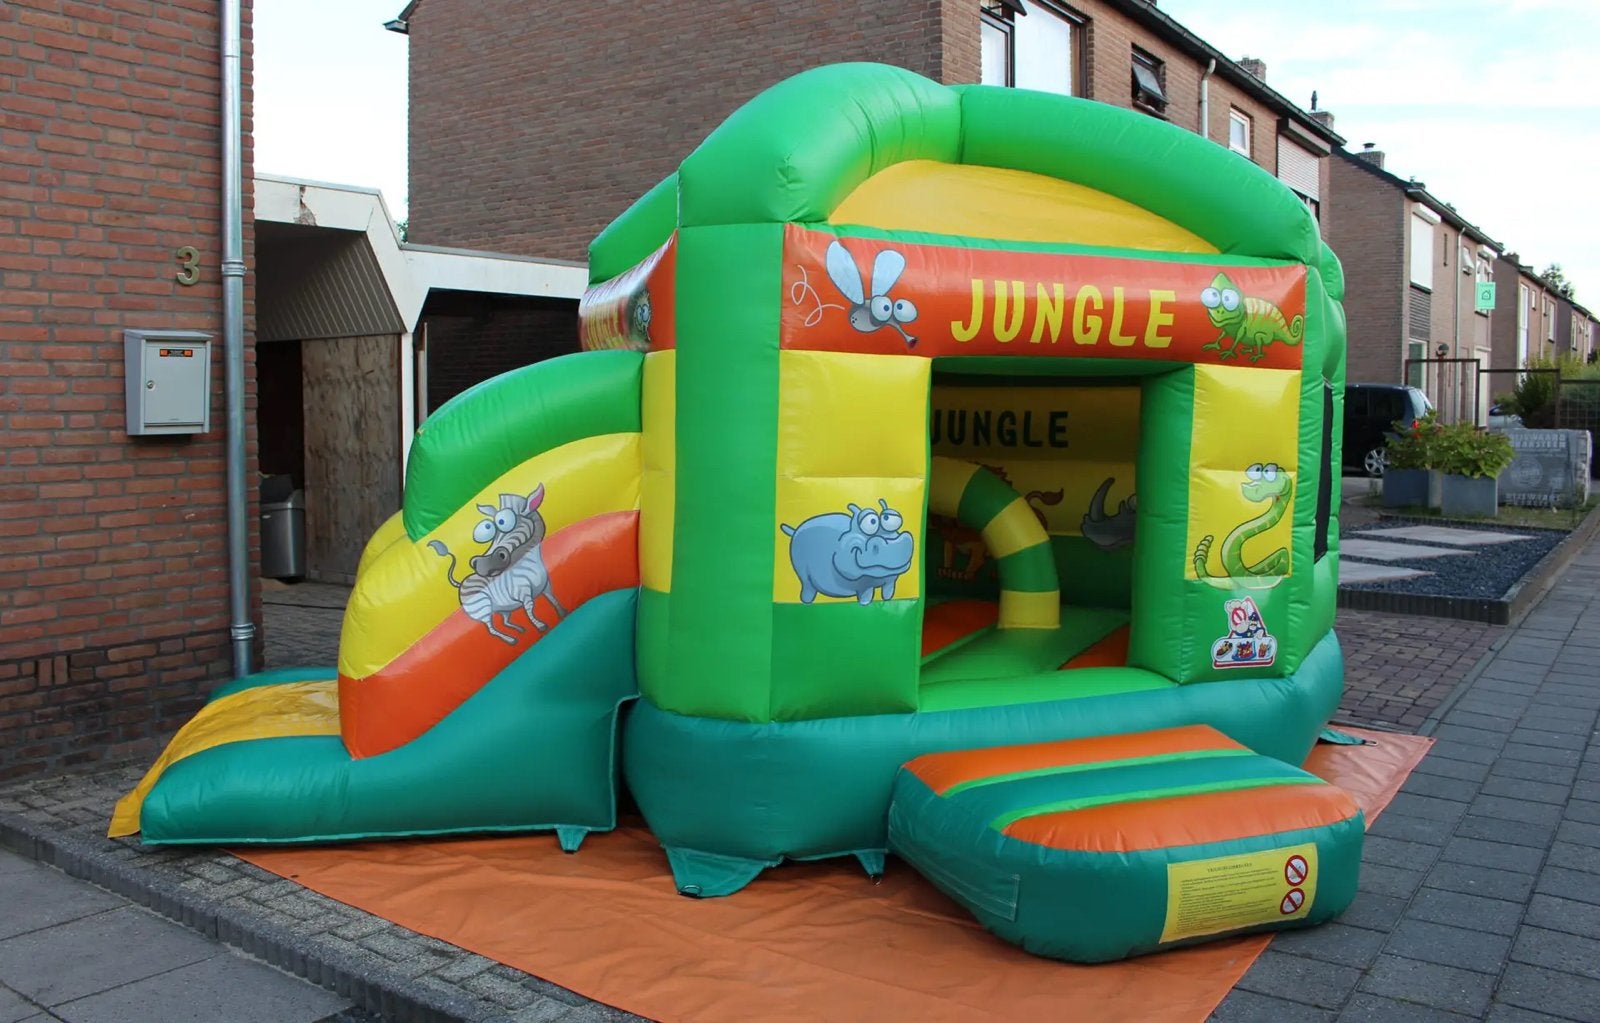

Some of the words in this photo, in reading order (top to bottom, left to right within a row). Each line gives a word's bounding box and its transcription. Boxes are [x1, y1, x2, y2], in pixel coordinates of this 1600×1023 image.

[177, 245, 200, 285] 3
[951, 279, 1176, 348] JUNGLE
[931, 409, 1069, 448] JUNGLE
